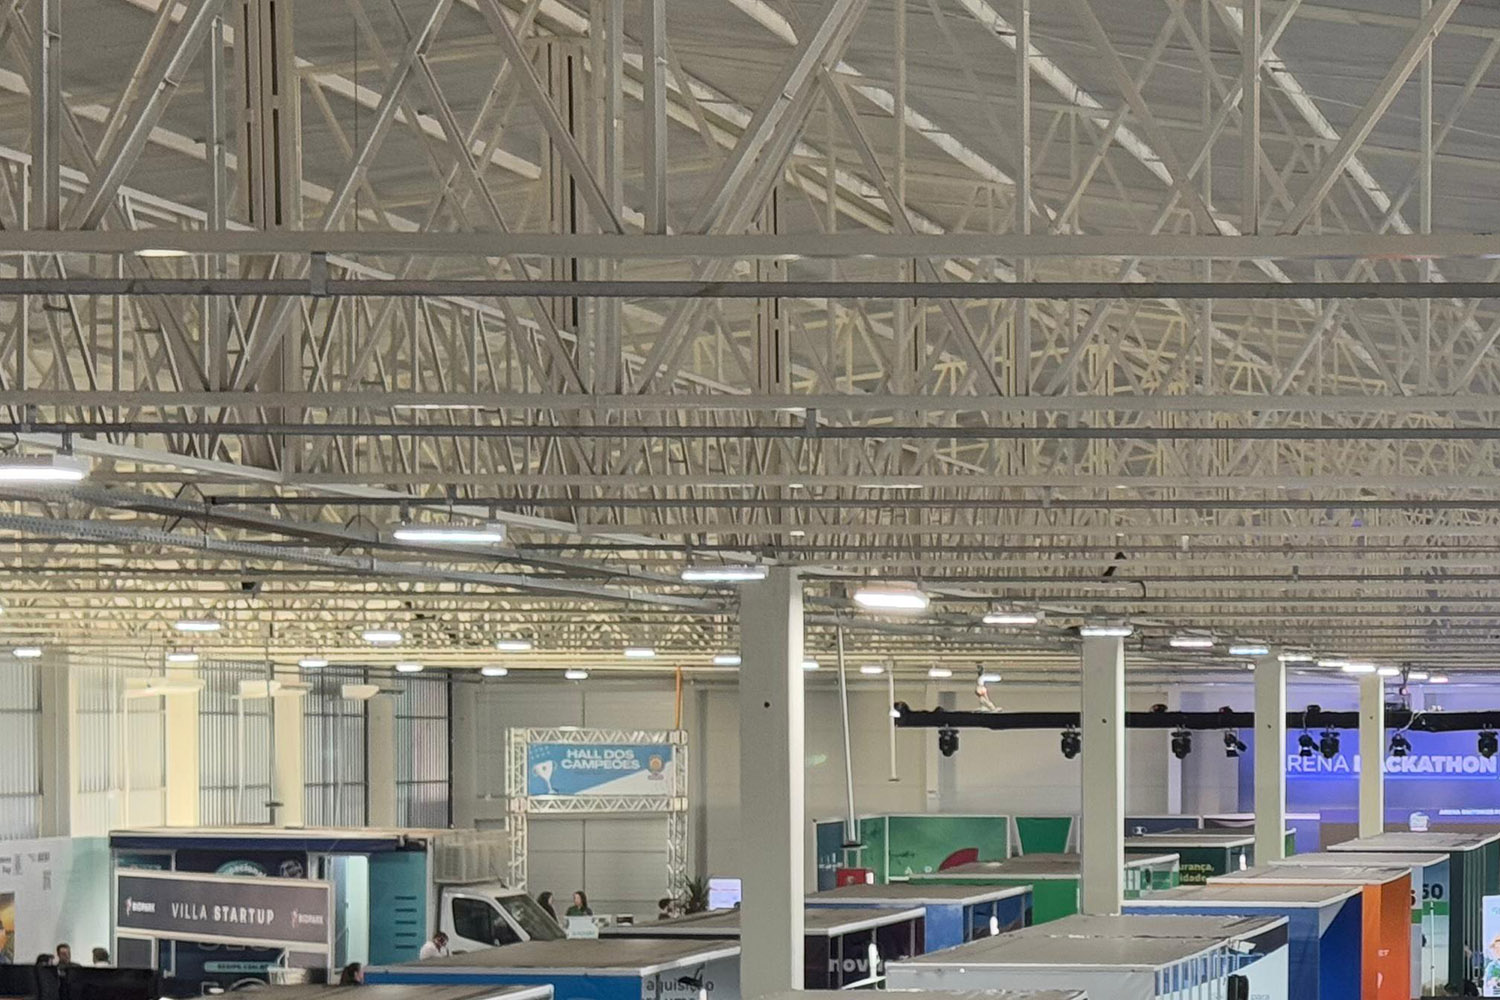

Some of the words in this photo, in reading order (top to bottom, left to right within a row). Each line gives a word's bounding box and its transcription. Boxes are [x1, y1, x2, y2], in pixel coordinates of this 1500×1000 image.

[566, 749, 601, 759] HALL
[603, 749, 635, 760] DOS
[1286, 754, 1349, 773] RENA
[1353, 755, 1497, 773] CKATHON
[171, 902, 208, 920] VILLA
[213, 905, 275, 925] STARTUP
